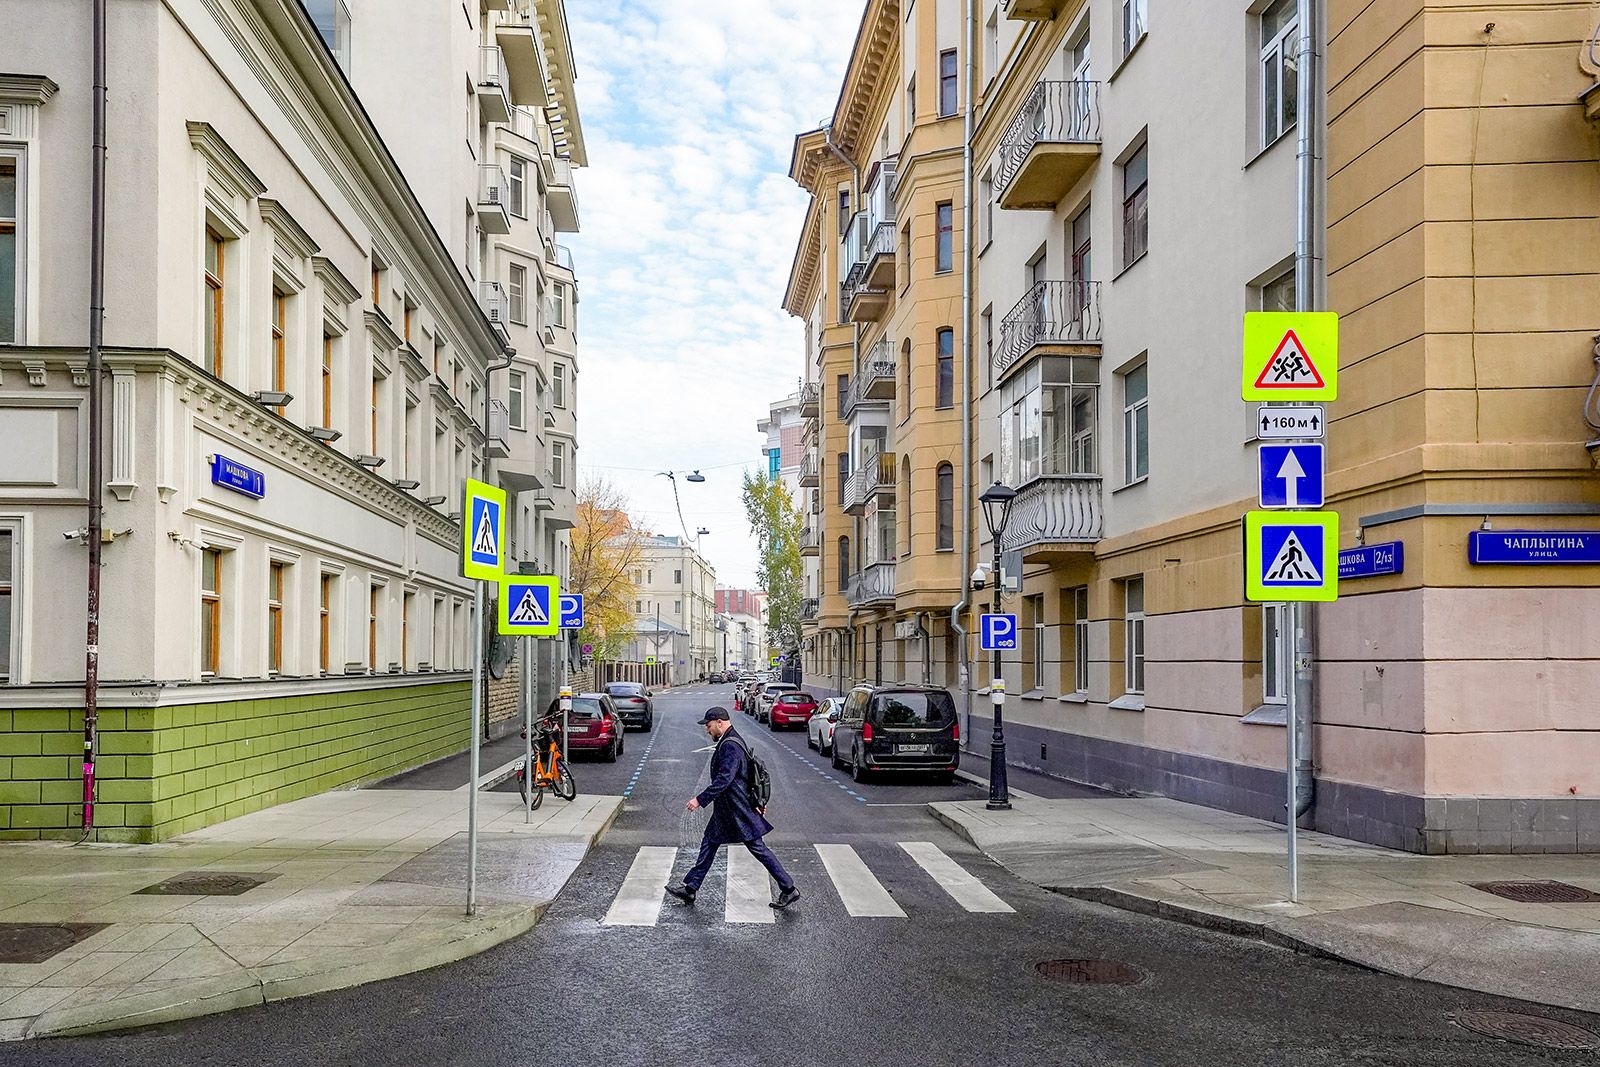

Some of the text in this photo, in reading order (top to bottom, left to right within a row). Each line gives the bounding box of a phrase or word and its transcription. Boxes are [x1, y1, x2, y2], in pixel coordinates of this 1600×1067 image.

[1272, 417, 1296, 428] 160
[256, 476, 261, 493] 1
[1503, 538, 1585, 549] ЧАПЛЫГИНА
[1338, 553, 1366, 566] ШКОВА
[1375, 550, 1393, 565] 2/13
[990, 616, 1012, 648] P
